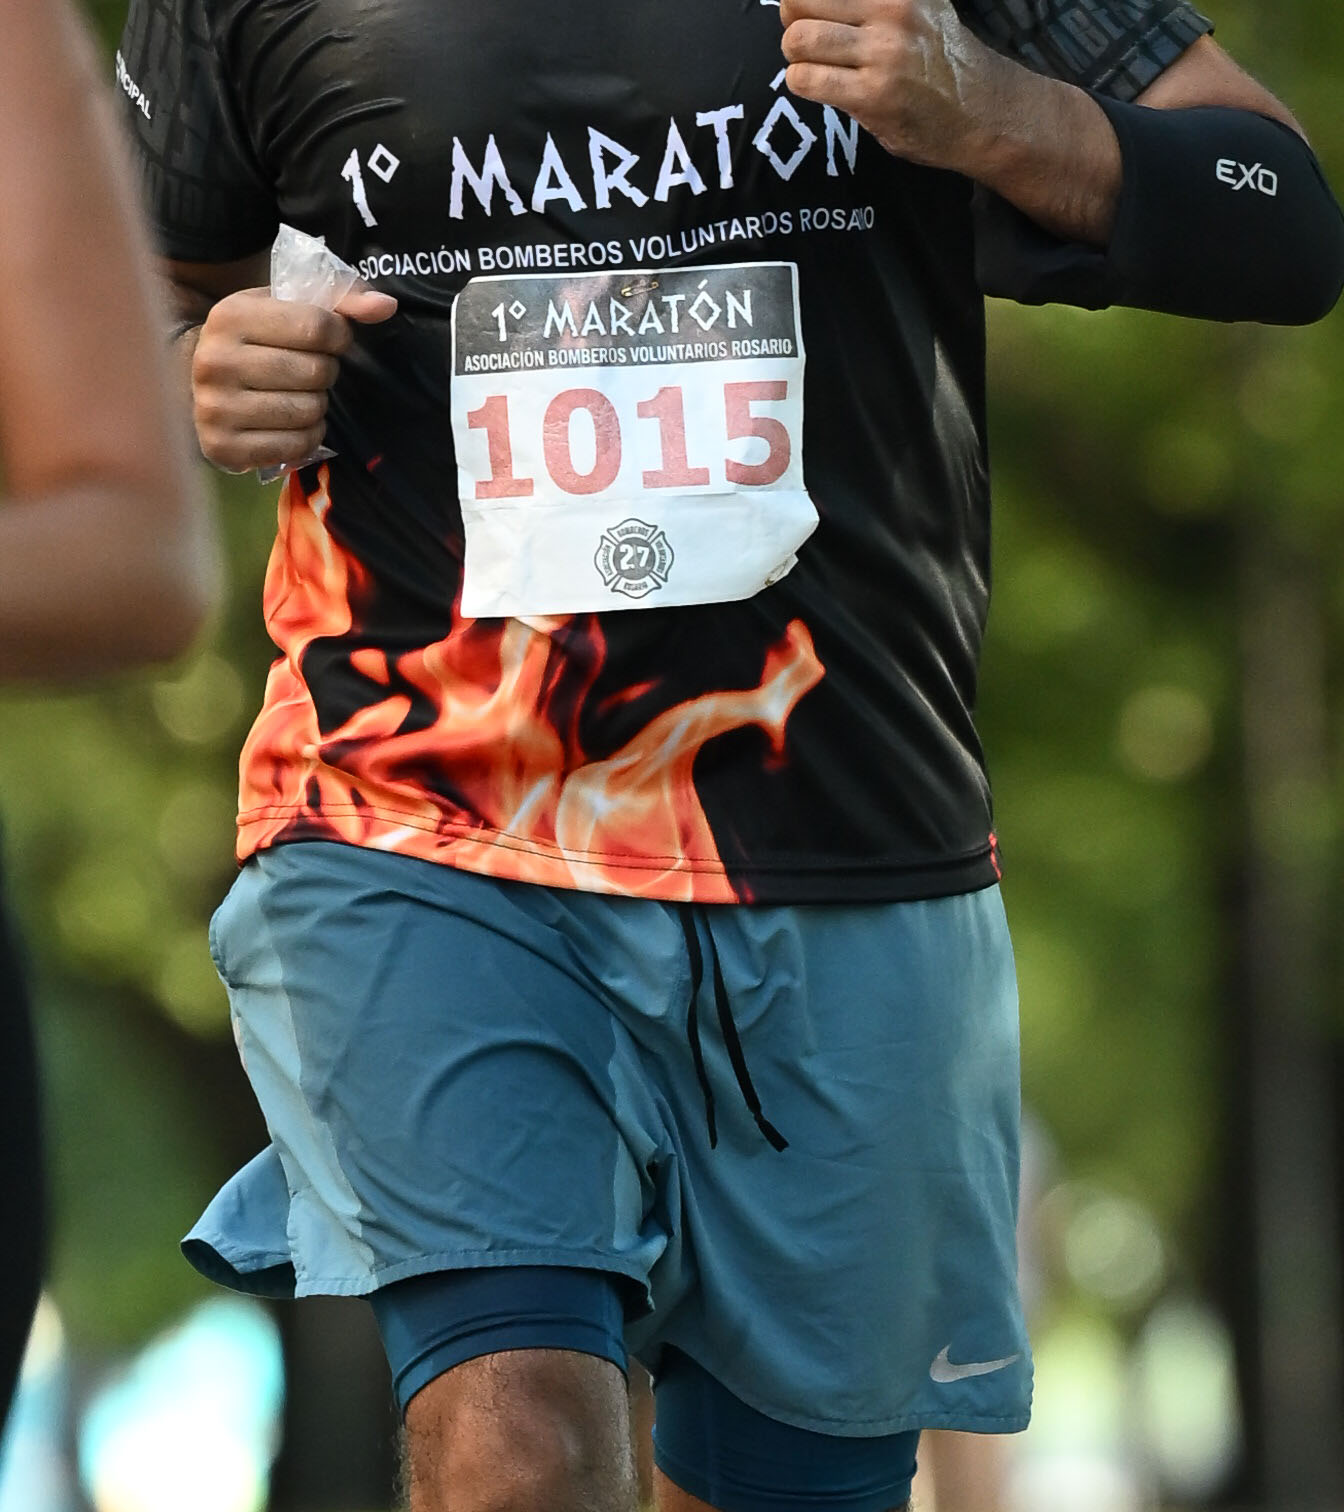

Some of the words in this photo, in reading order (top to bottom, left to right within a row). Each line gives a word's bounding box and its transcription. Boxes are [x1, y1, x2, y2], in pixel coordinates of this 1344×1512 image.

[449, 68, 858, 219] MARATÓN
[1216, 158, 1278, 196] EXO
[356, 245, 471, 281] SOCIACIÓN
[477, 241, 624, 271] BOMBEROS
[543, 279, 754, 338] MARATÓN
[464, 348, 544, 372] ASOCIACIÓN
[547, 347, 627, 366] BOMBEROS
[630, 341, 727, 362] VOLUNTARIOS
[731, 338, 793, 356] ROSARIO
[467, 380, 791, 499] 1015
[619, 544, 650, 570] 27
